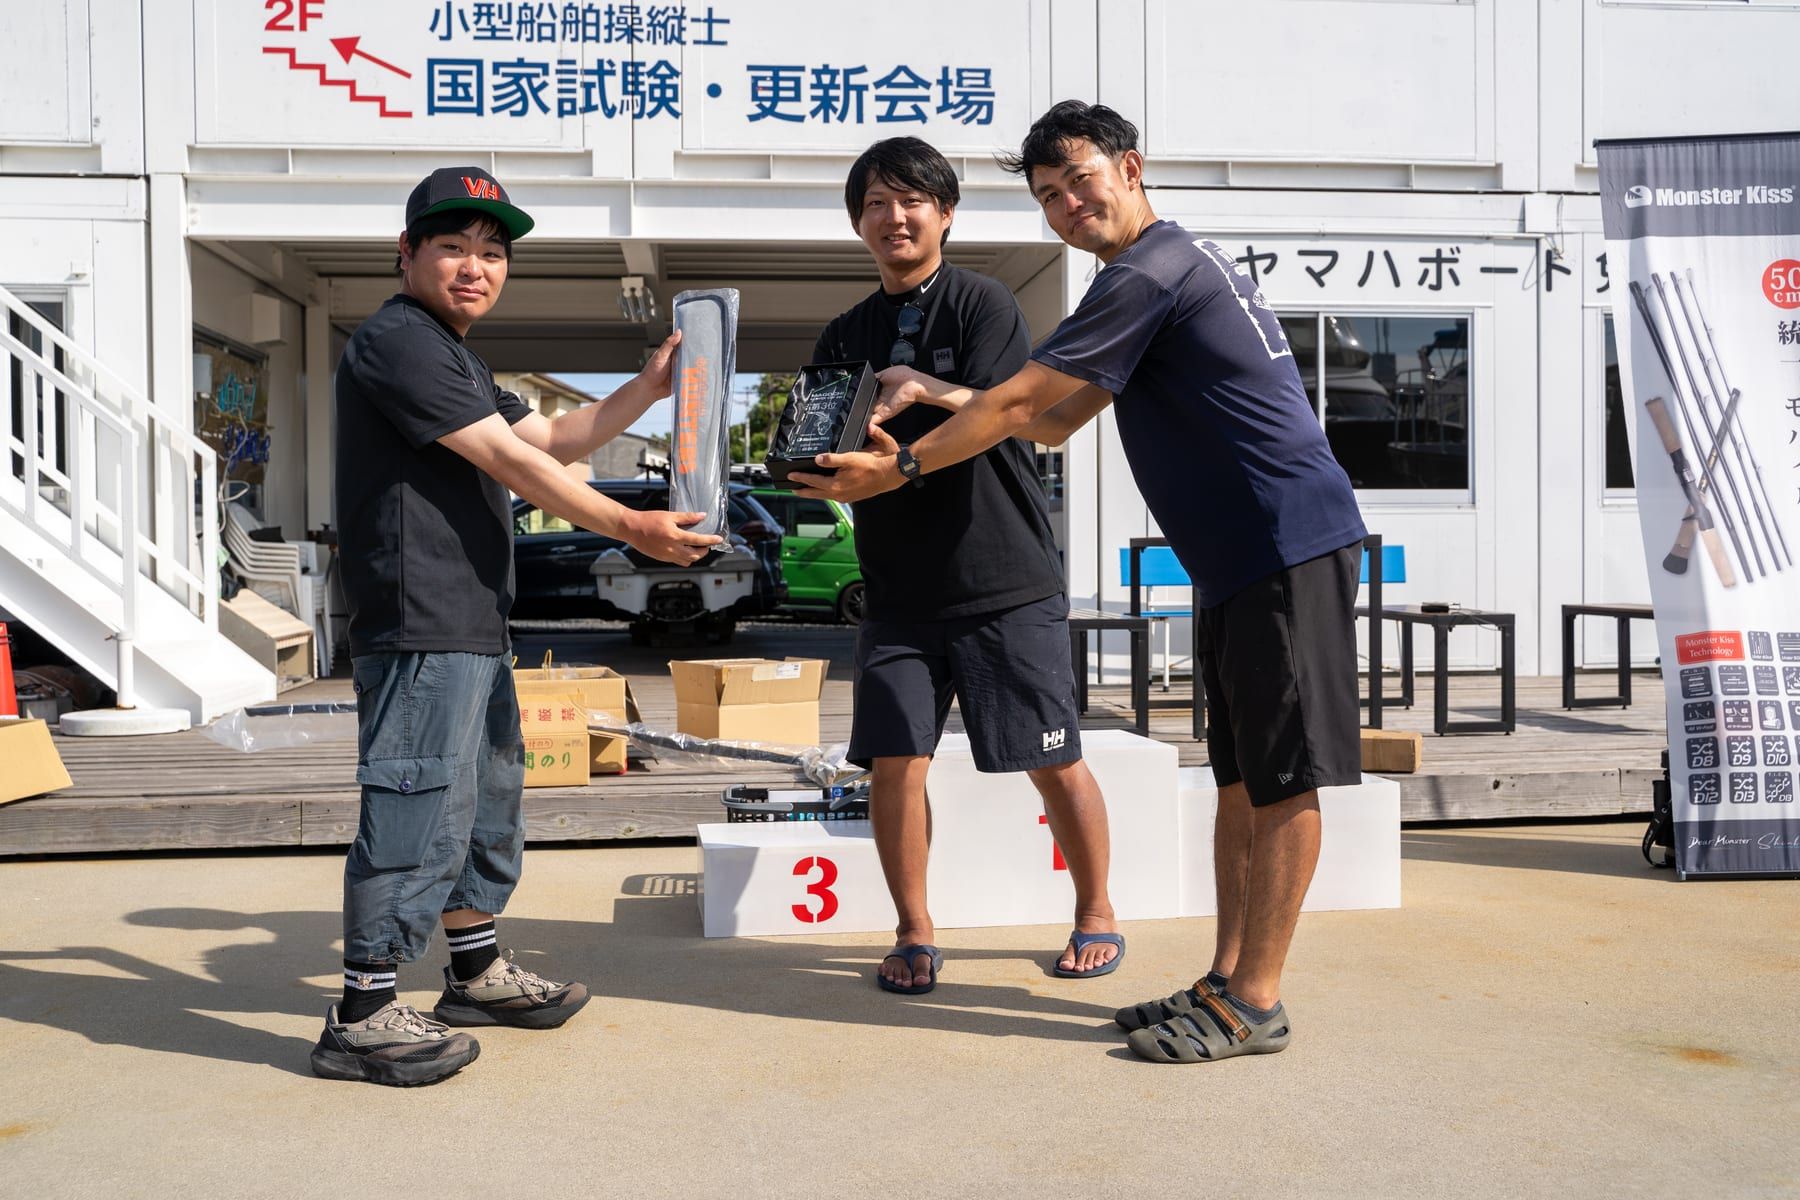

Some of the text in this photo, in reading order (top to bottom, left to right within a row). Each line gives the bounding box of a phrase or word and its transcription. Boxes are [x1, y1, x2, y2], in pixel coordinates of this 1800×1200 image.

[264, 0, 324, 32] 2F
[428, 0, 731, 46] 小型船舶操縦士
[426, 57, 996, 125] 国家試験・更新会場
[461, 176, 501, 200] VH
[1655, 185, 1794, 207] Monster Kiss
[1685, 636, 1735, 647] Monster Kiss
[1689, 647, 1734, 657] Technology
[1043, 728, 1065, 748] HH
[1692, 756, 1714, 768] D8
[1732, 754, 1752, 765] D9
[1694, 792, 1719, 804] D12
[1733, 791, 1755, 802] D13
[792, 856, 839, 923] 3
